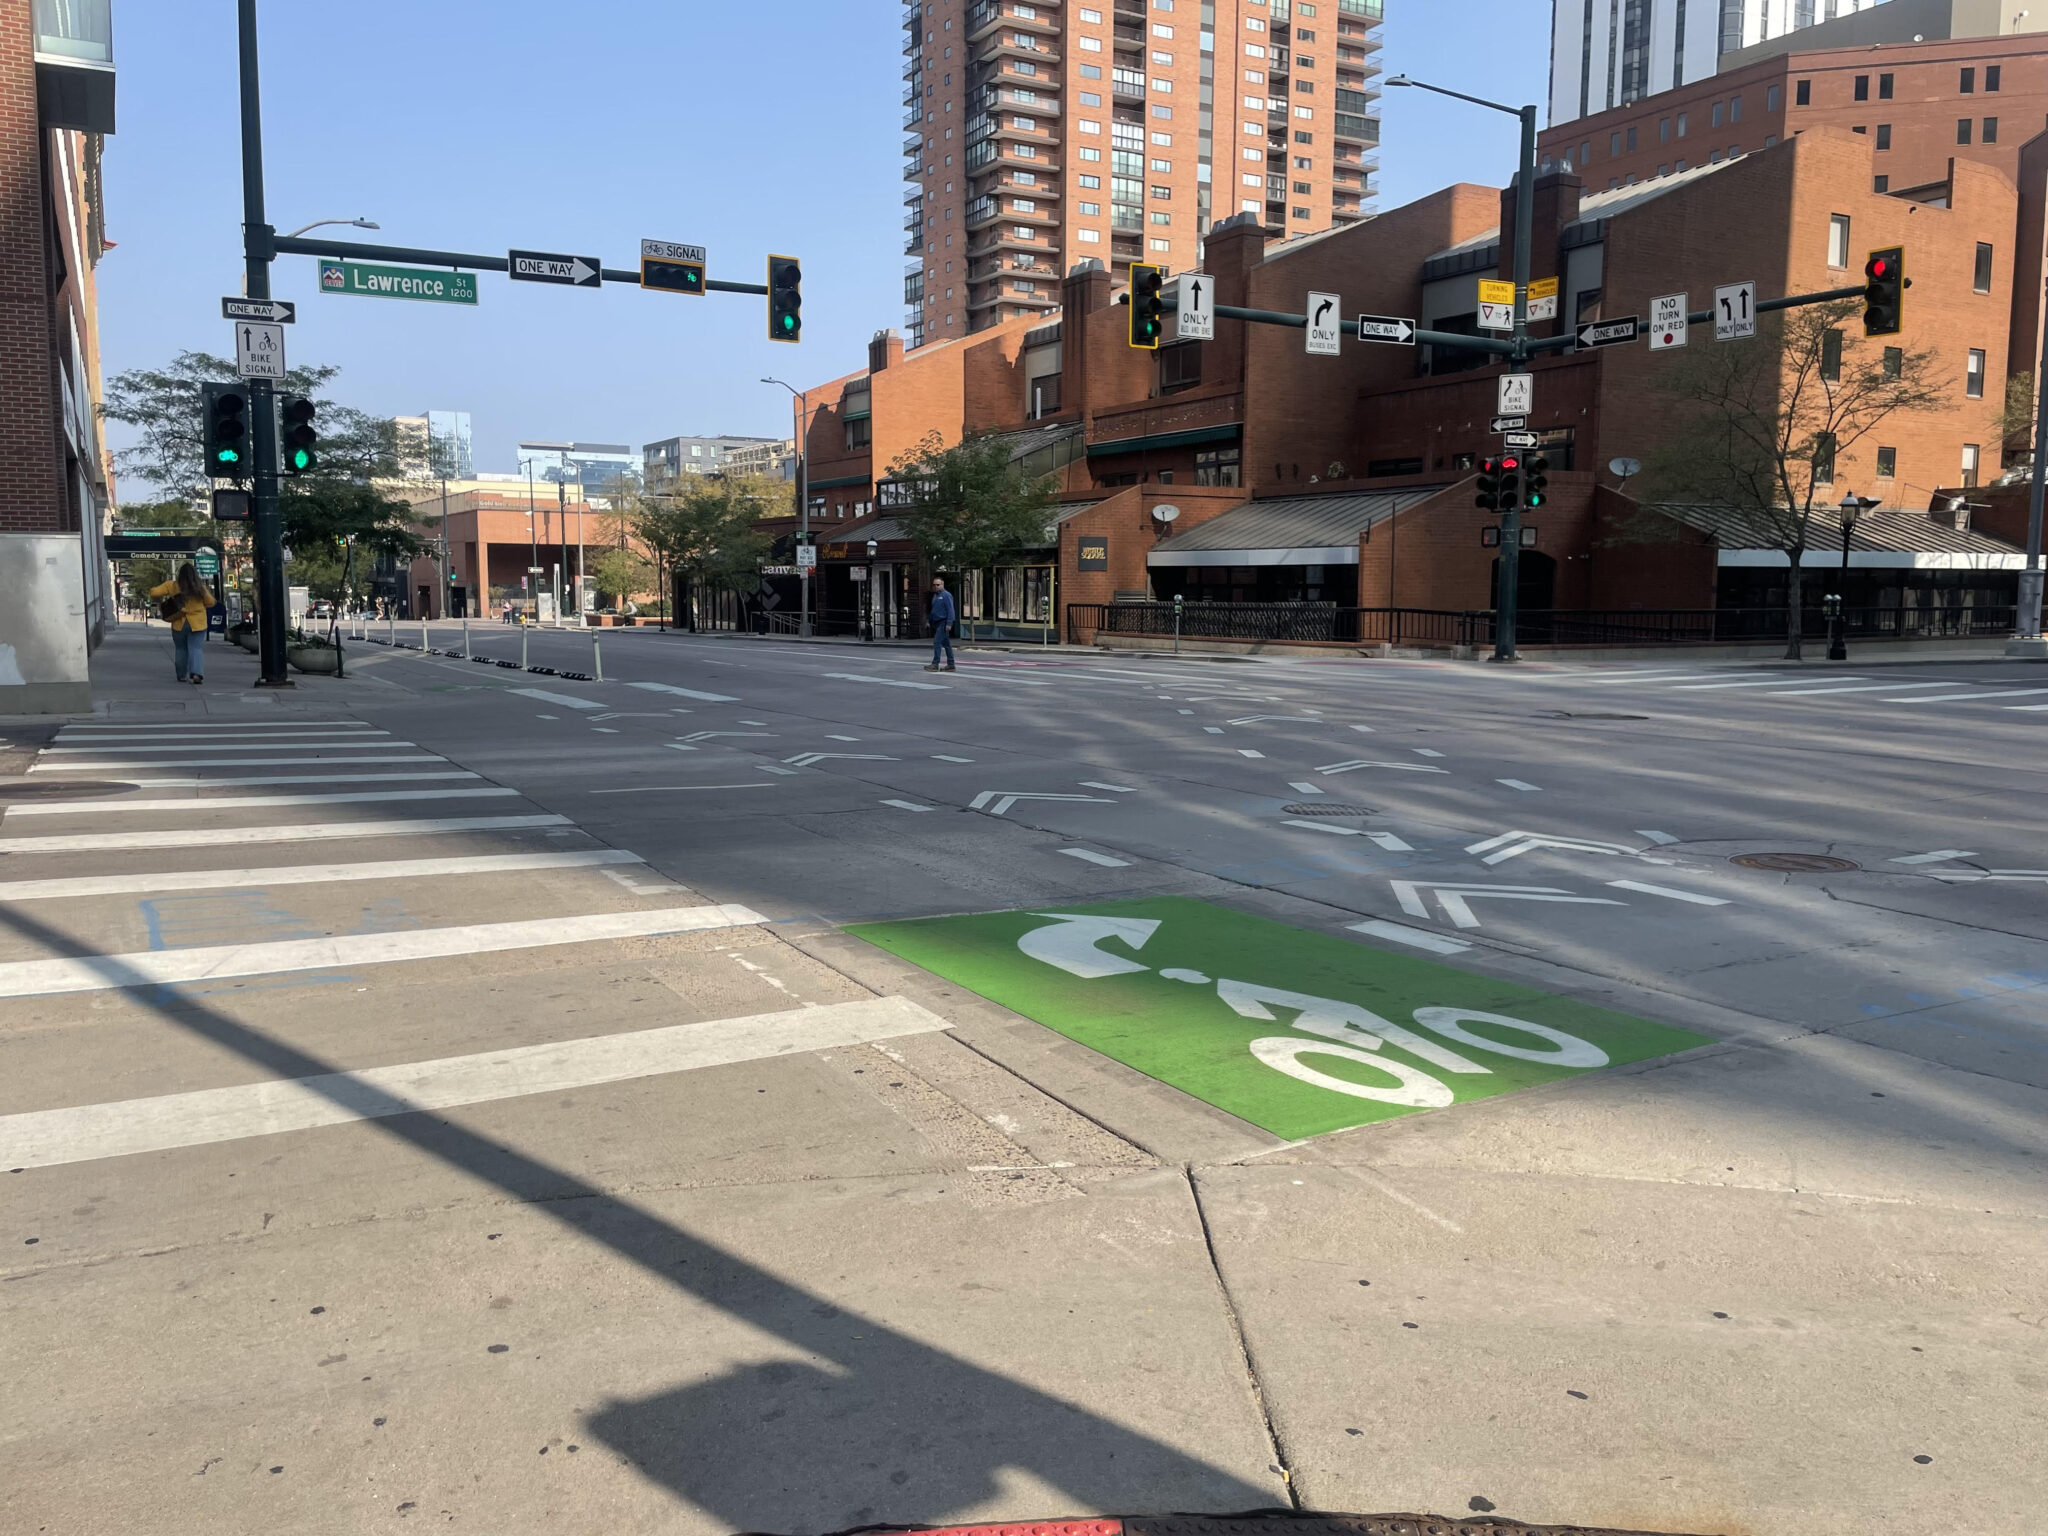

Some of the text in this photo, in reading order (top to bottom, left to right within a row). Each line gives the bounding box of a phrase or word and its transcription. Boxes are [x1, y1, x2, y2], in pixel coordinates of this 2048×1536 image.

[666, 245, 703, 260] SIGNAL
[519, 259, 574, 276] ONE WAY
[353, 268, 466, 296] Lawrence St
[450, 288, 473, 298] 1200
[230, 304, 273, 315] ONE WAY
[1660, 299, 1676, 310] NO
[1183, 313, 1208, 325] ONLY
[1658, 310, 1680, 321] TURN
[1365, 323, 1398, 335] ONE WAY
[1594, 324, 1631, 339] ONE WAY
[1653, 321, 1684, 333] ON RED
[1717, 325, 1734, 335] ONLY
[1735, 322, 1753, 332] ONLY
[1312, 329, 1335, 340] ONLY
[251, 354, 271, 363] BIKE
[246, 364, 278, 375] SIGNAL
